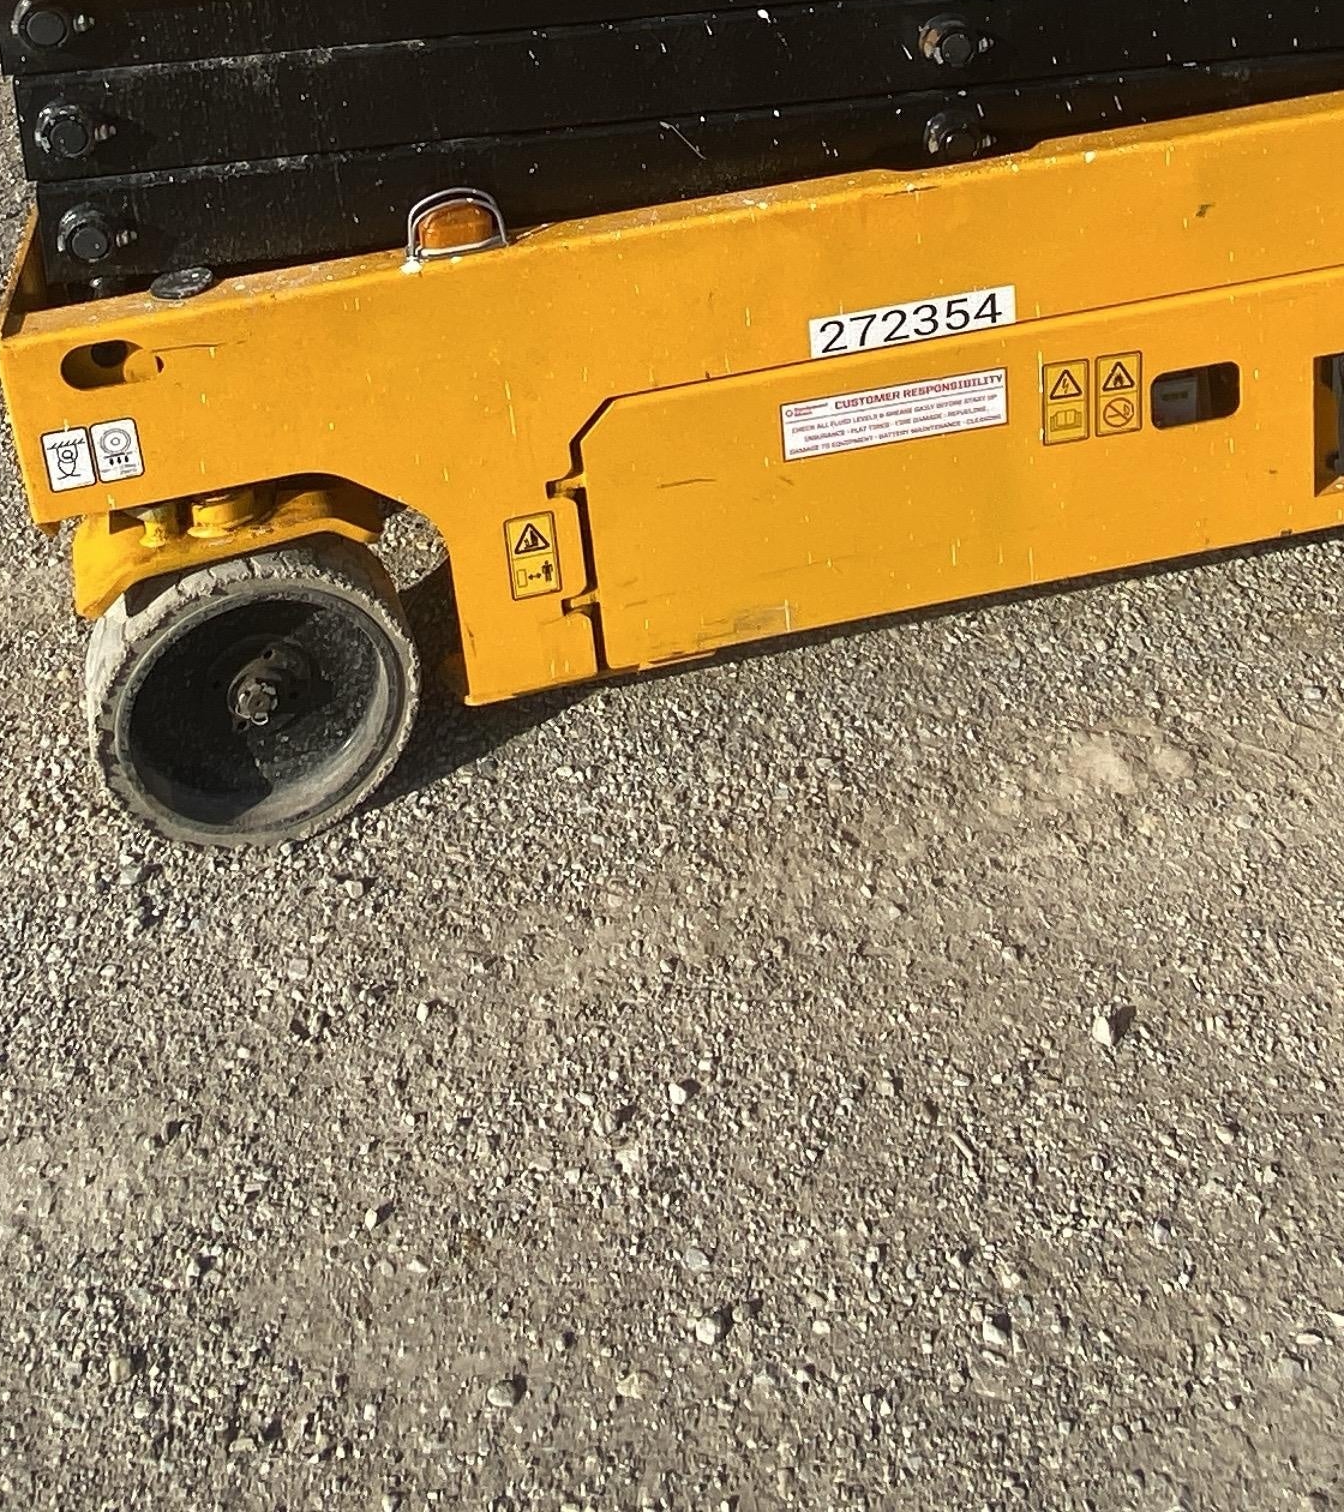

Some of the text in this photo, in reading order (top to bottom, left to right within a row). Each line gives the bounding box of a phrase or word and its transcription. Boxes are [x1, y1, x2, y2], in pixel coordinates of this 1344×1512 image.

[819, 292, 1002, 354] 272354
[834, 391, 900, 410] CUSTOMER
[902, 374, 1003, 399] RESPONSIBILITY
